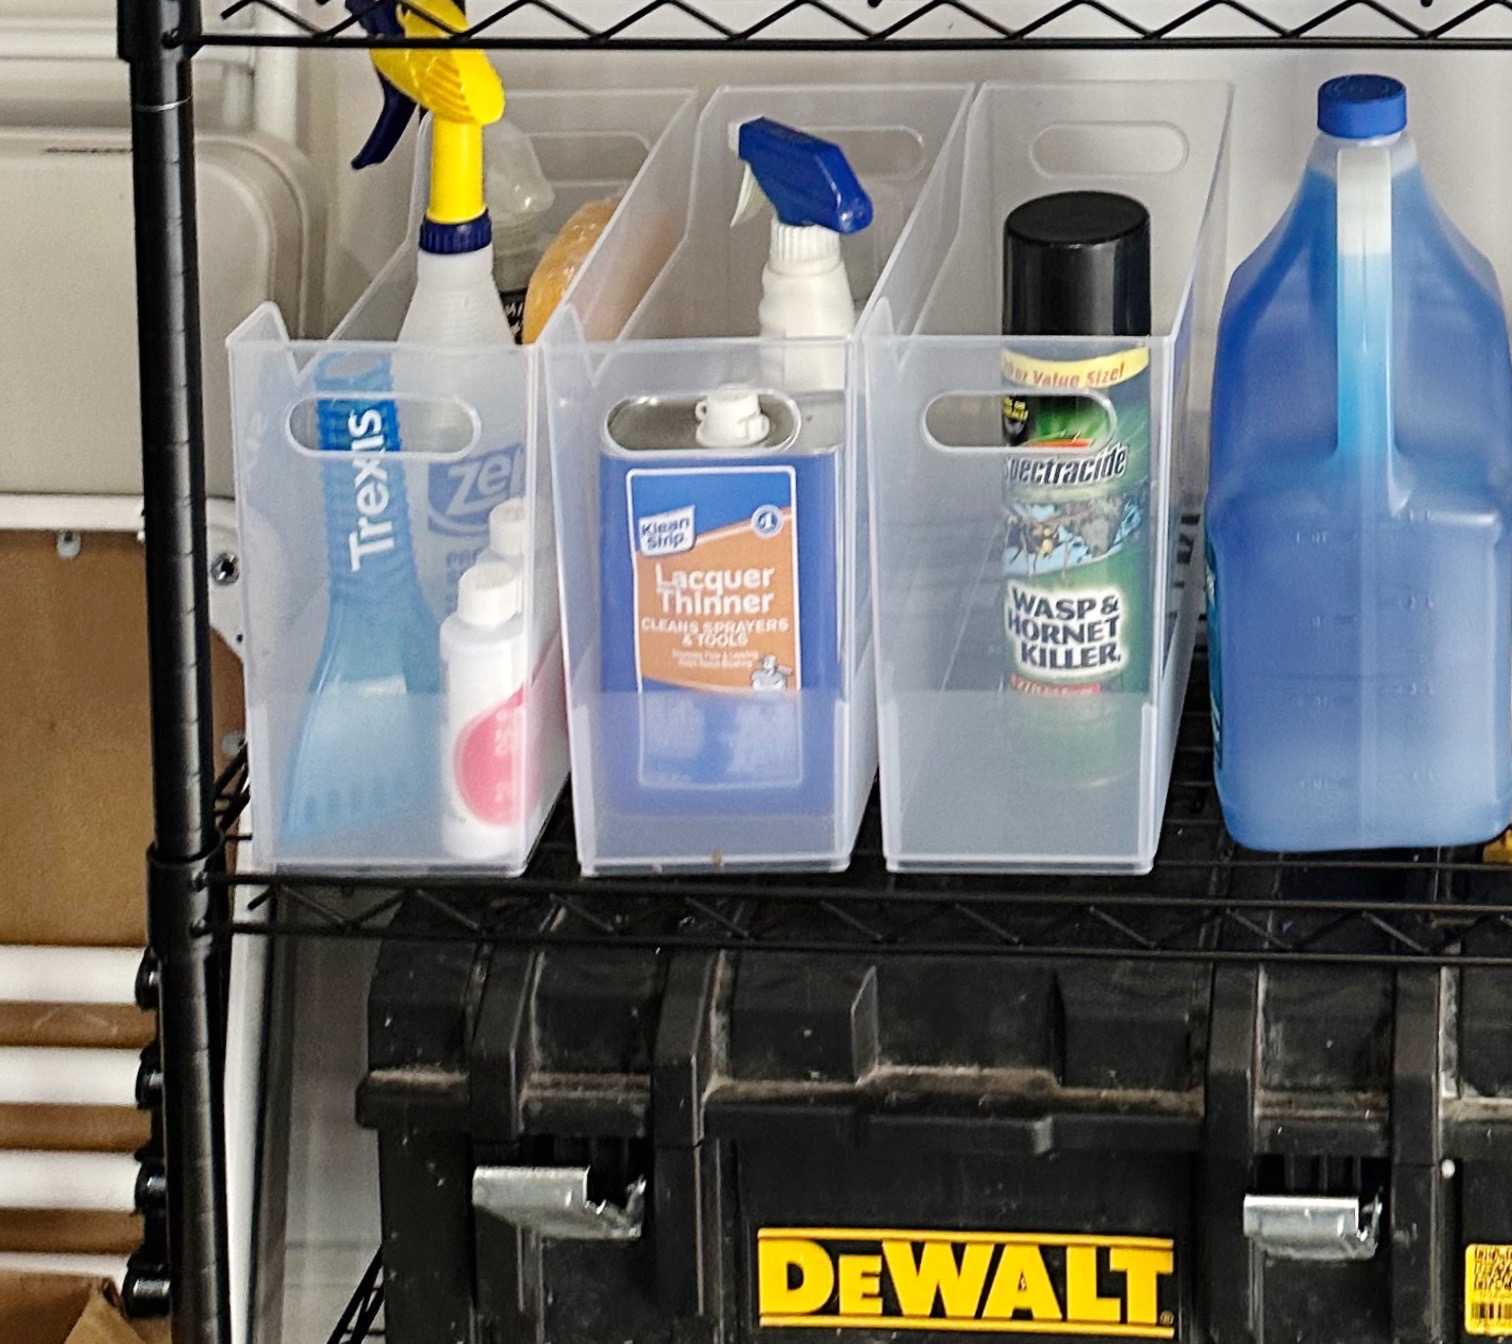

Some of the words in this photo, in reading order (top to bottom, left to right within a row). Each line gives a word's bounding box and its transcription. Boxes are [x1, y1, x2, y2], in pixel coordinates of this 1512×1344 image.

[1033, 370, 1080, 388] Value
[1086, 362, 1126, 386] Size!
[641, 517, 692, 536] Klean
[646, 532, 685, 551] Strip
[655, 563, 775, 594] Lacquer
[659, 589, 775, 616] Thinner
[1012, 586, 1097, 620] WASP
[1100, 594, 1119, 616] &
[641, 617, 700, 634] CLEANS
[702, 618, 789, 634] SPRAYERS
[1008, 608, 1119, 645] HORNET
[696, 633, 748, 648] TOOLS
[758, 1238, 1172, 1326] DEWALT
